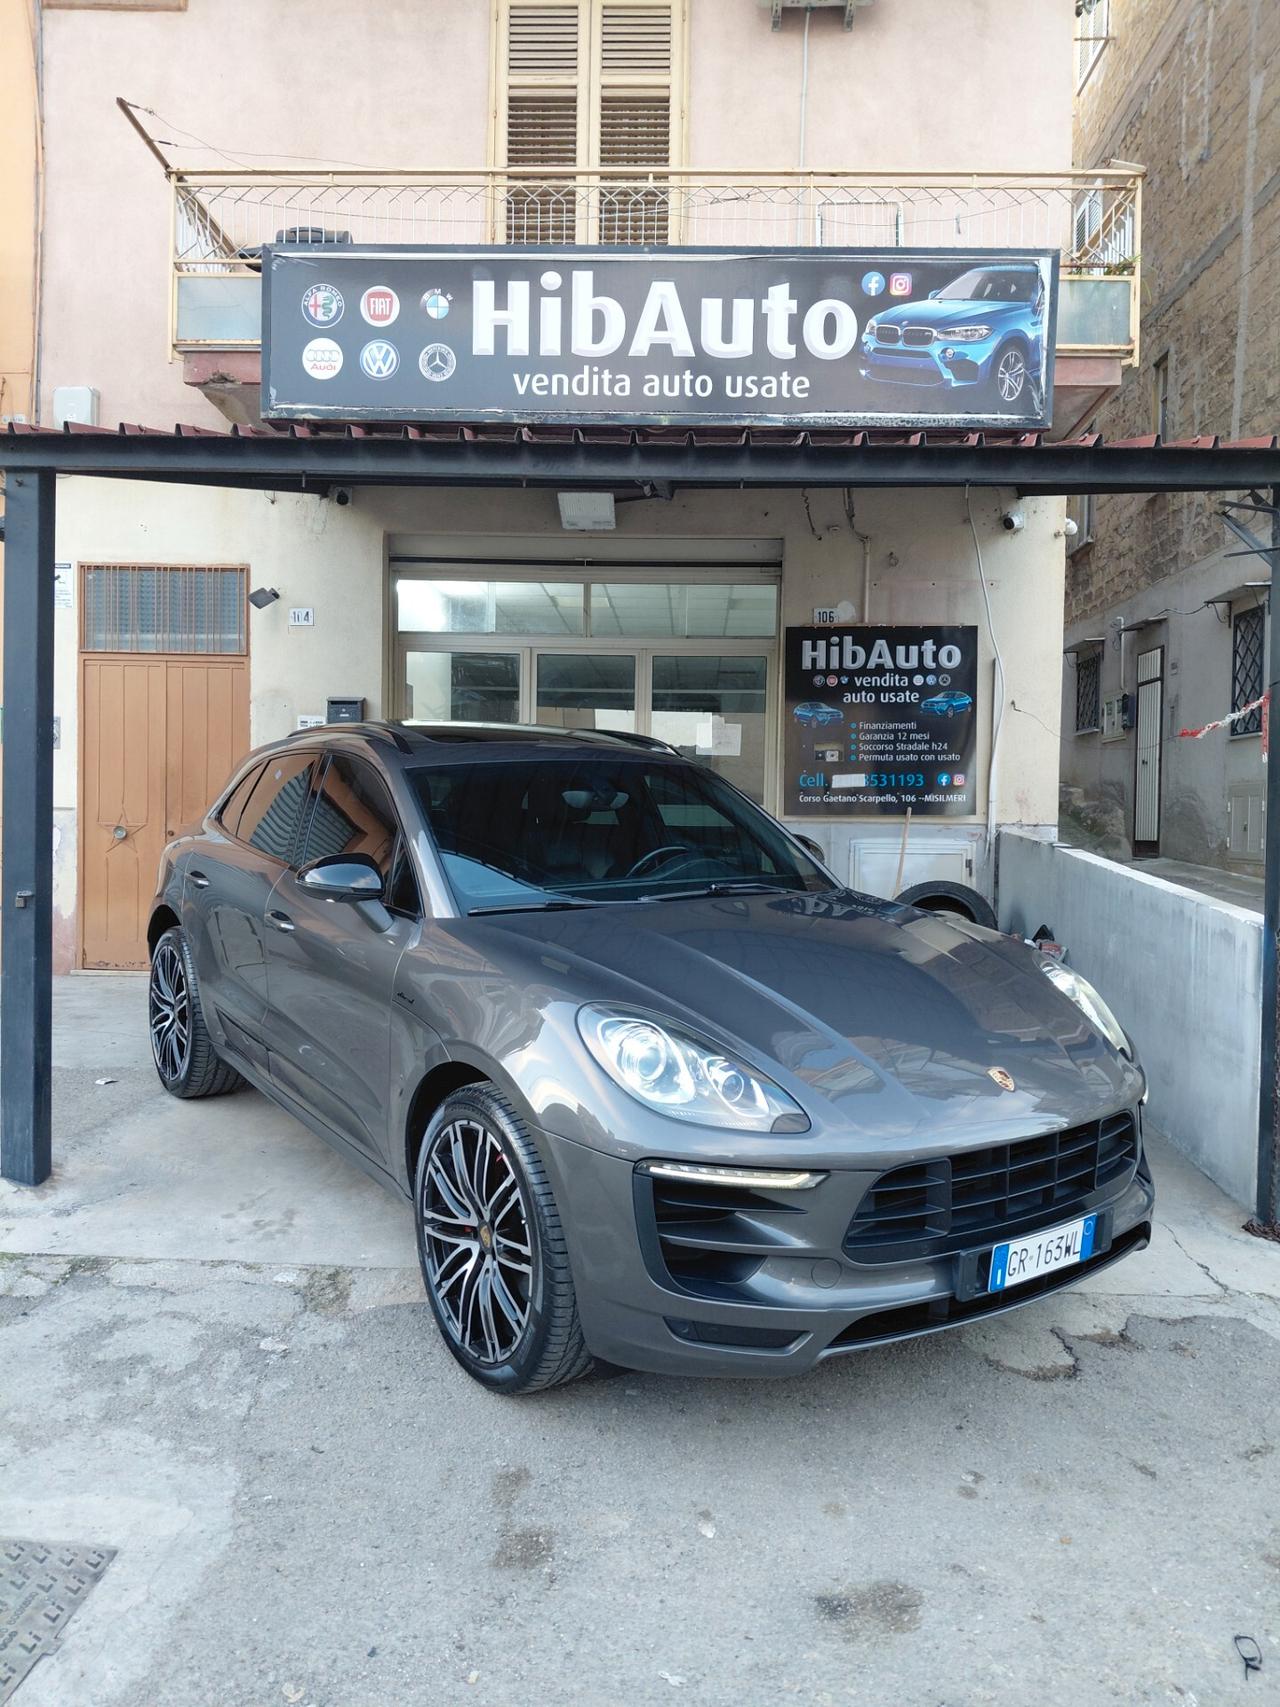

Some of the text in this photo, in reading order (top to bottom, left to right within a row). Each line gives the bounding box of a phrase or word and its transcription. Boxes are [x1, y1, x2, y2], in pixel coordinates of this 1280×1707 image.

[303, 286, 342, 308] ALFA ROMEO
[423, 288, 454, 301] BMW
[370, 297, 392, 316] FIAT
[472, 270, 858, 360] HibAuto
[310, 362, 336, 371] Audi
[513, 365, 810, 399] vendita auto usate
[818, 610, 835, 623] 106
[801, 635, 962, 670] HibAuto
[854, 673, 909, 687] vendita
[843, 691, 920, 704] auto usate
[859, 721, 917, 730] Finanziamenti
[859, 731, 930, 740] Garanzia 12 mesi
[859, 742, 948, 751] Soccorso Stradale h24
[859, 753, 894, 761] Permuta
[896, 753, 919, 761] usato
[937, 753, 961, 761] usato
[799, 772, 828, 787] Cell.
[799, 794, 821, 803] Corso
[823, 794, 857, 803] Gaetano
[859, 793, 898, 804] Scarpello,
[901, 794, 916, 802] 106
[1008, 1248, 1029, 1277] GR
[1035, 1231, 1080, 1268] 163WL
